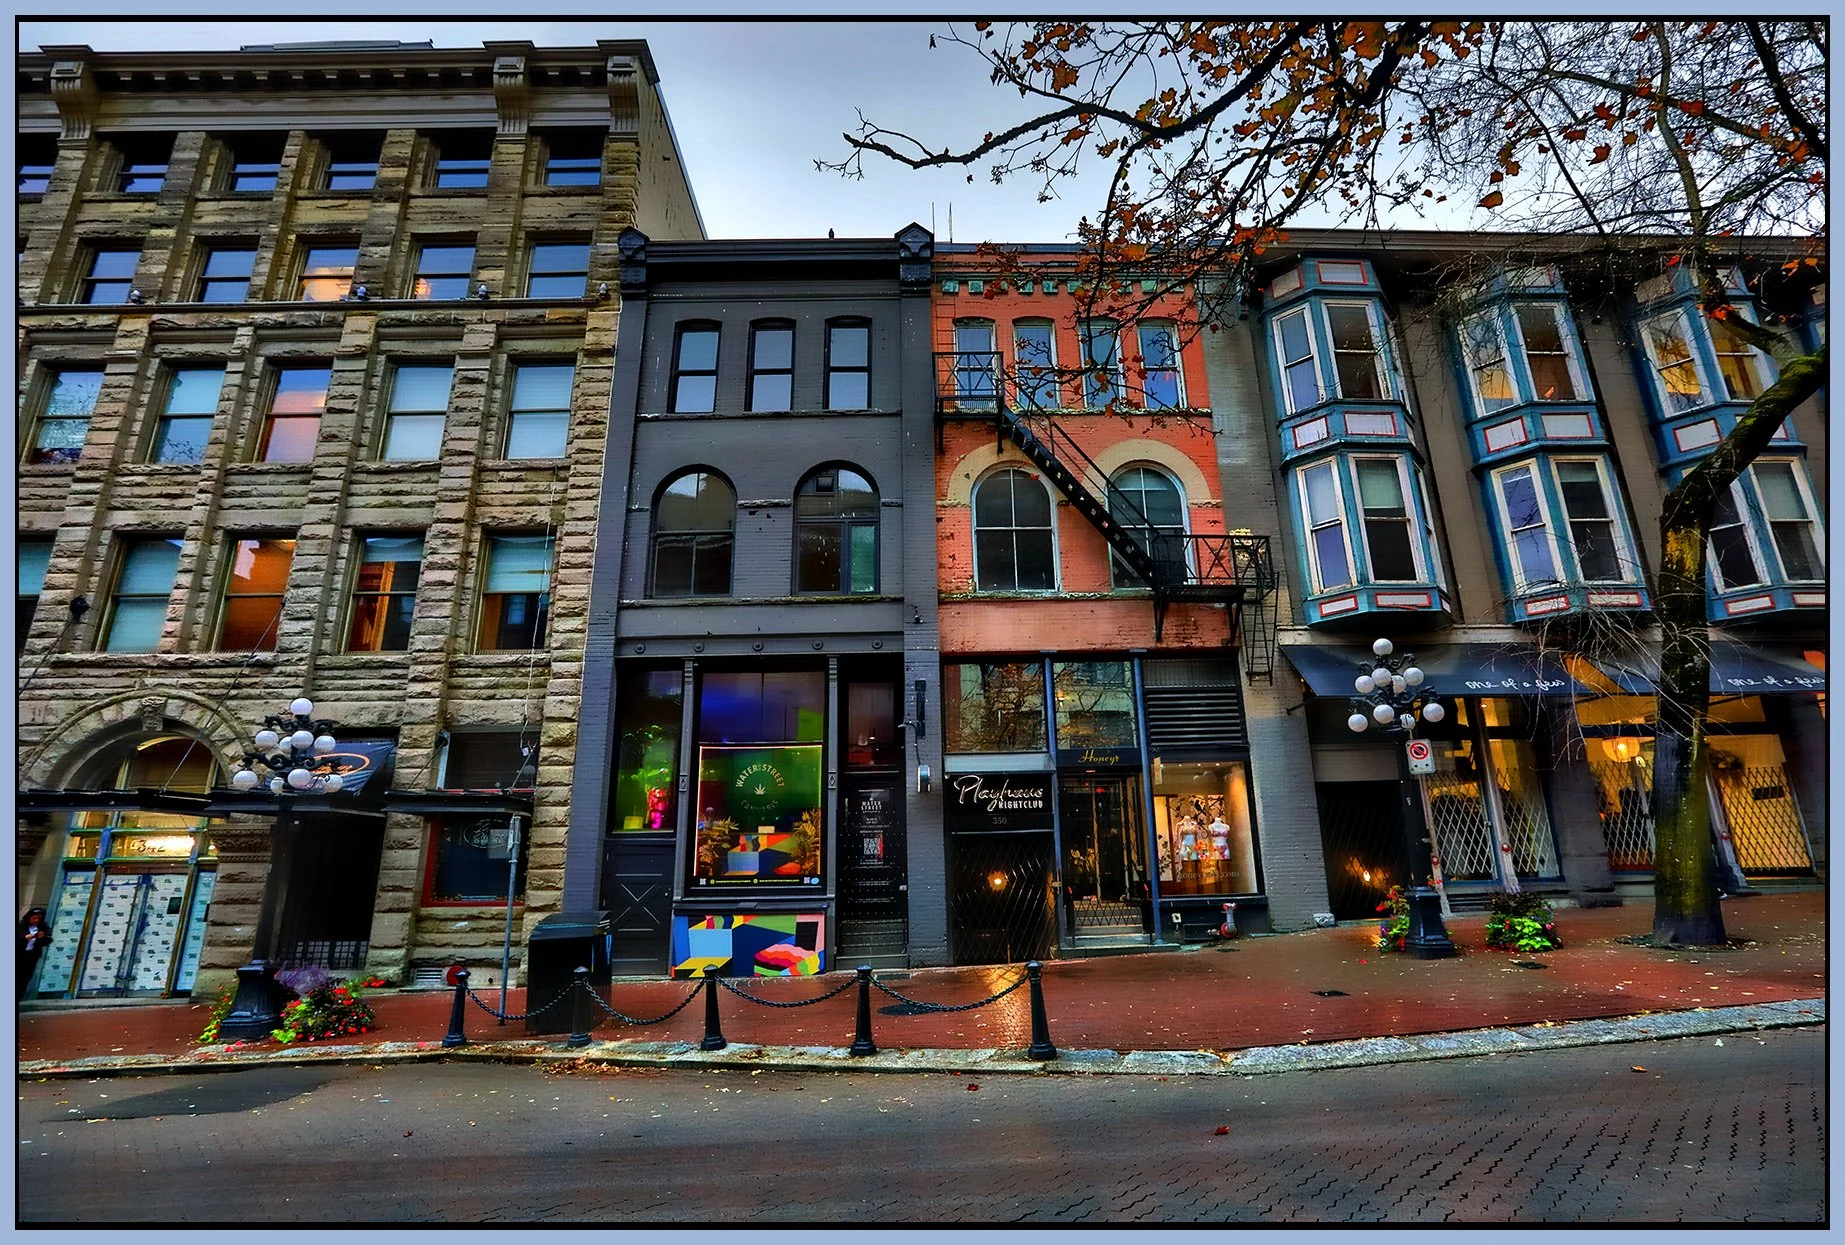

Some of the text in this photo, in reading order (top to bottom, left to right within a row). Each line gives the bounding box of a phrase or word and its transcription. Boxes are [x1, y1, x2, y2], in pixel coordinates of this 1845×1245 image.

[1465, 680, 1500, 691] one
[1501, 677, 1519, 691] of
[1534, 679, 1566, 692] few
[1727, 678, 1762, 687] one
[1763, 675, 1783, 688] of
[735, 763, 786, 788] WATER STREET
[998, 800, 1044, 810] NIGHTCLUB
[991, 817, 1008, 826] 350
